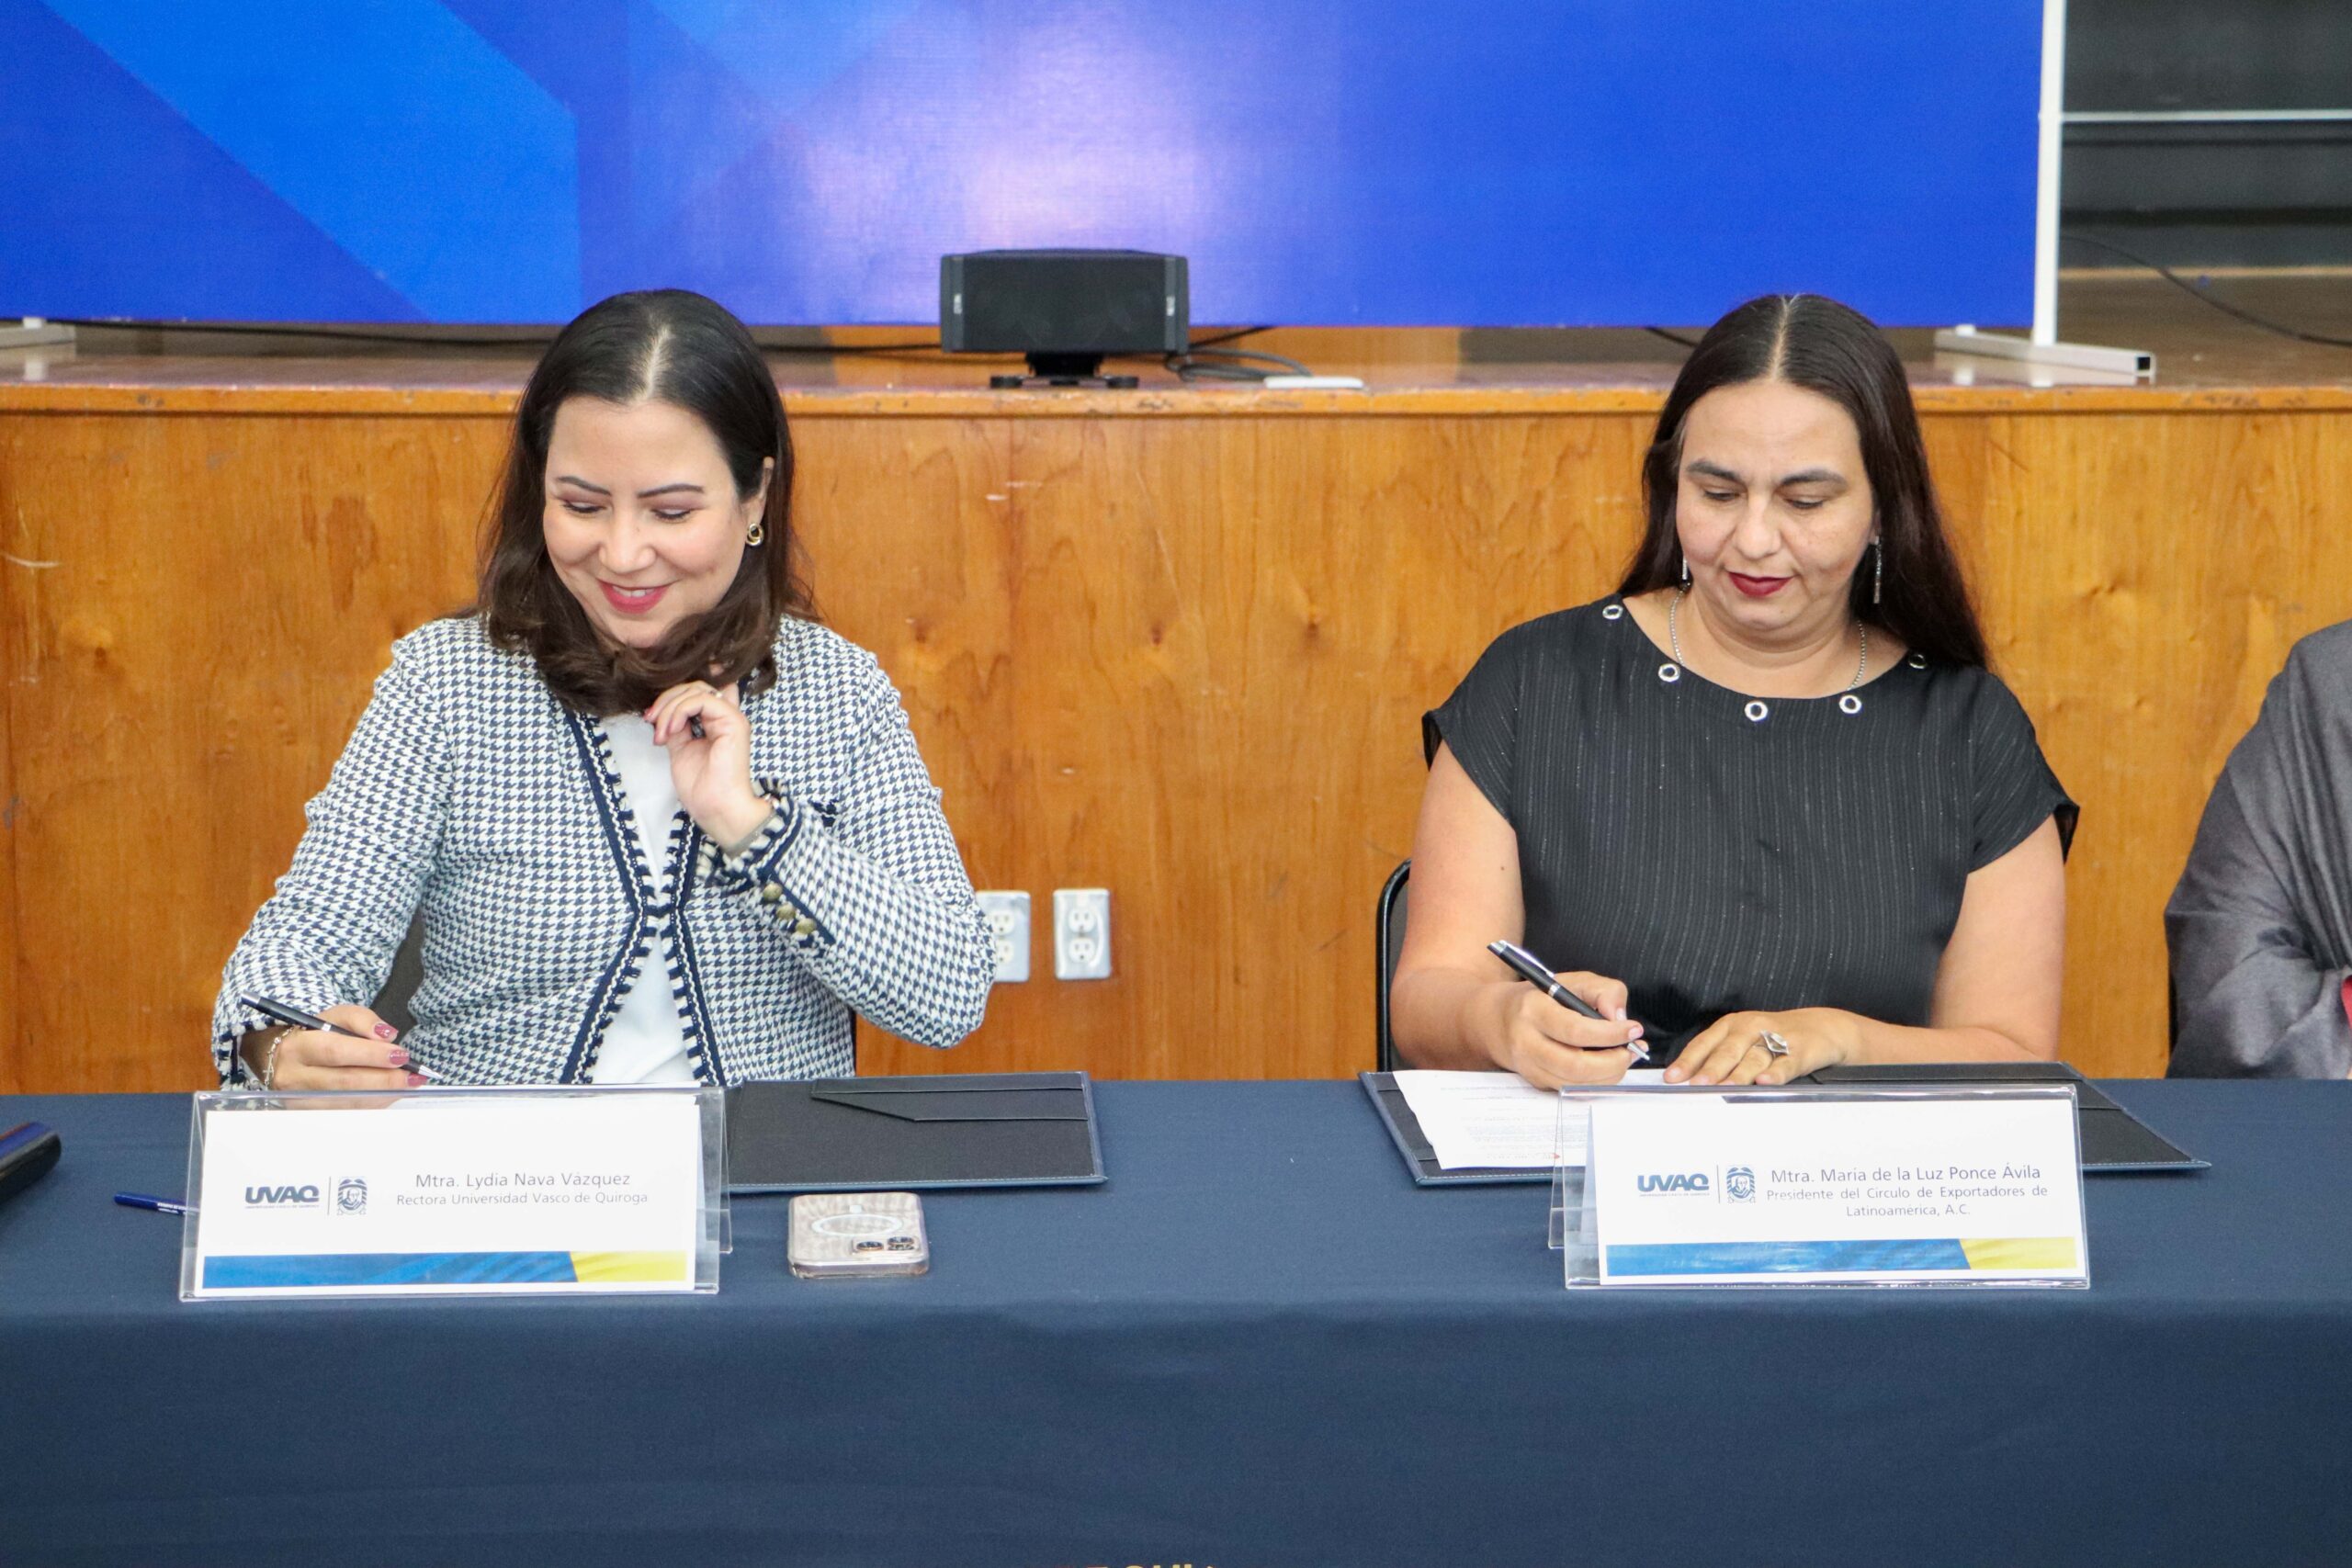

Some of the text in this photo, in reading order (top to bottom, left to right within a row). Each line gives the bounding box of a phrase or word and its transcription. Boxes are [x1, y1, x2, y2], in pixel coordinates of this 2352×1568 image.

[415, 1171, 630, 1190] Mtra. Lydia Nava Vázquez
[1771, 1169, 1815, 1183] Mtra.
[1872, 1167, 1892, 1181] de
[1897, 1167, 1911, 1180] la
[1917, 1167, 1943, 1180] Luz
[1950, 1167, 1996, 1179] Ponce
[2002, 1162, 2041, 1179] Ávila
[1637, 1173, 1710, 1192] UVAQ
[244, 1185, 320, 1204] UVAQ
[397, 1191, 648, 1205] Rectora Universidad Vasco de Quiroga
[1767, 1190, 1834, 1201] Presidente
[1840, 1187, 1860, 1200] del
[1917, 1186, 1933, 1198] de
[1939, 1185, 2026, 1200] Exportadores
[2031, 1185, 2048, 1196] de
[1945, 1203, 1971, 1215] A.C.
